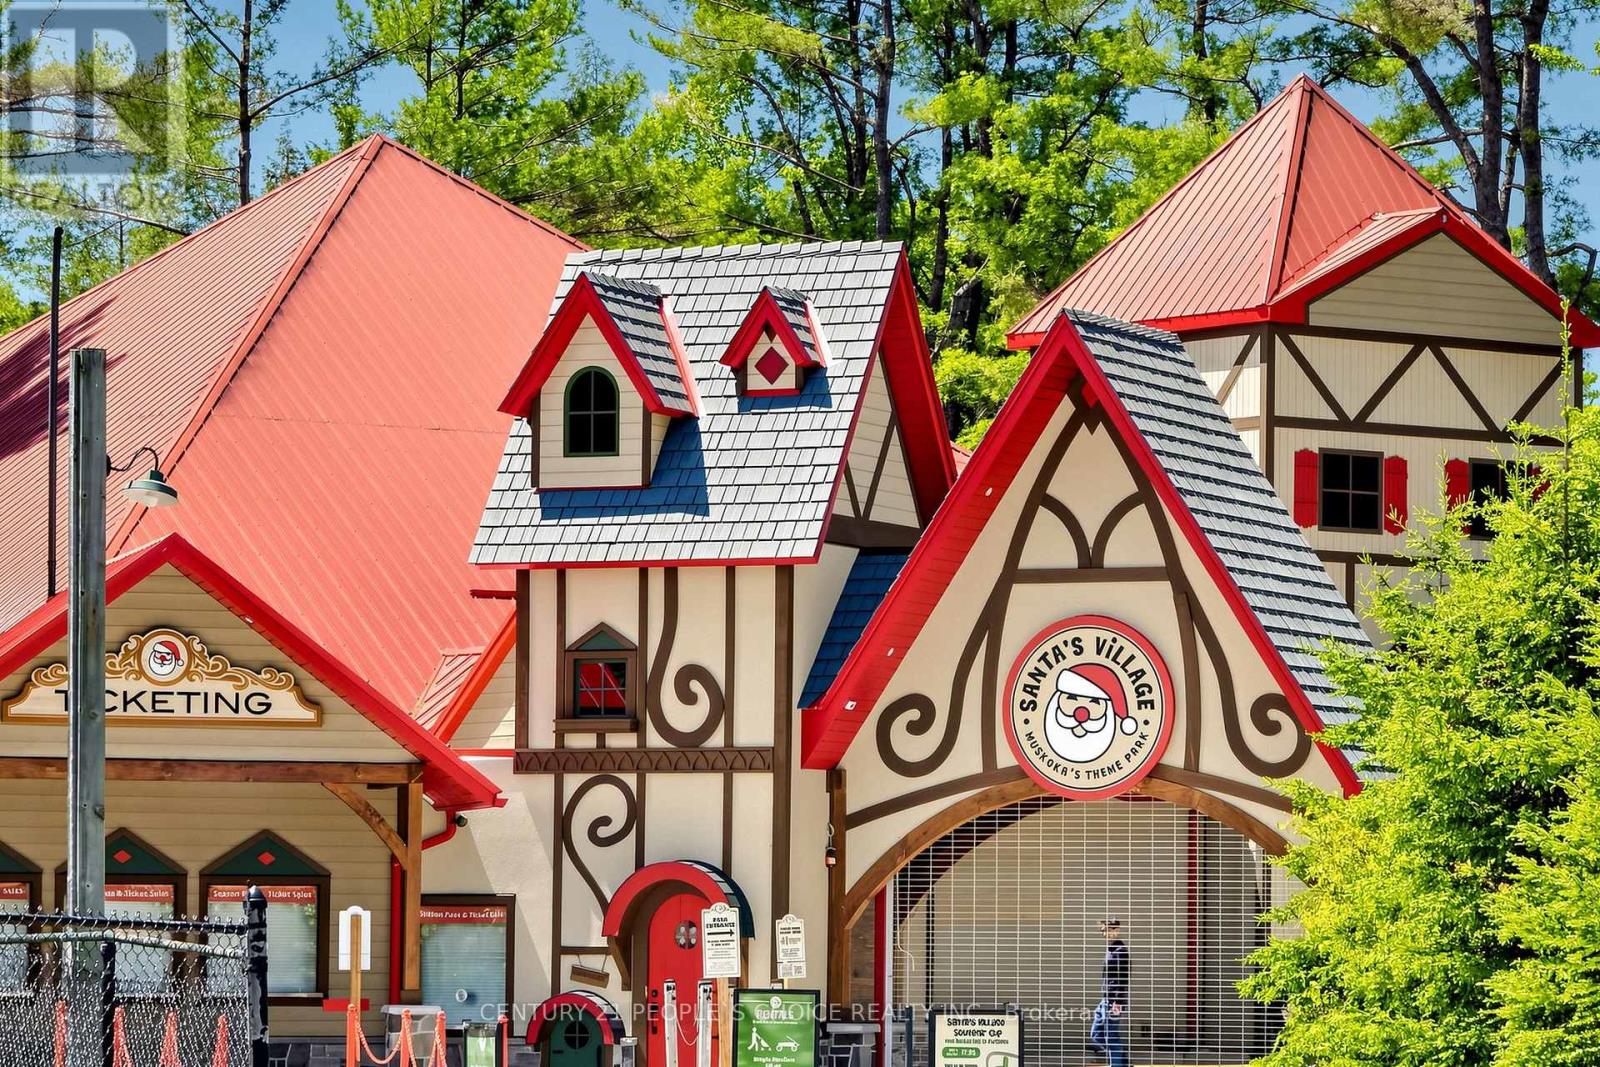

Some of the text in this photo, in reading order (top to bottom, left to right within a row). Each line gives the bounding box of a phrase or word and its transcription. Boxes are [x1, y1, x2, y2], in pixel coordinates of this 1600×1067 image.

[1020, 636, 1084, 712] SANTA'S
[54, 690, 272, 715] TCKETING
[1025, 731, 1149, 780] MUSKOKA'S THEME PARK
